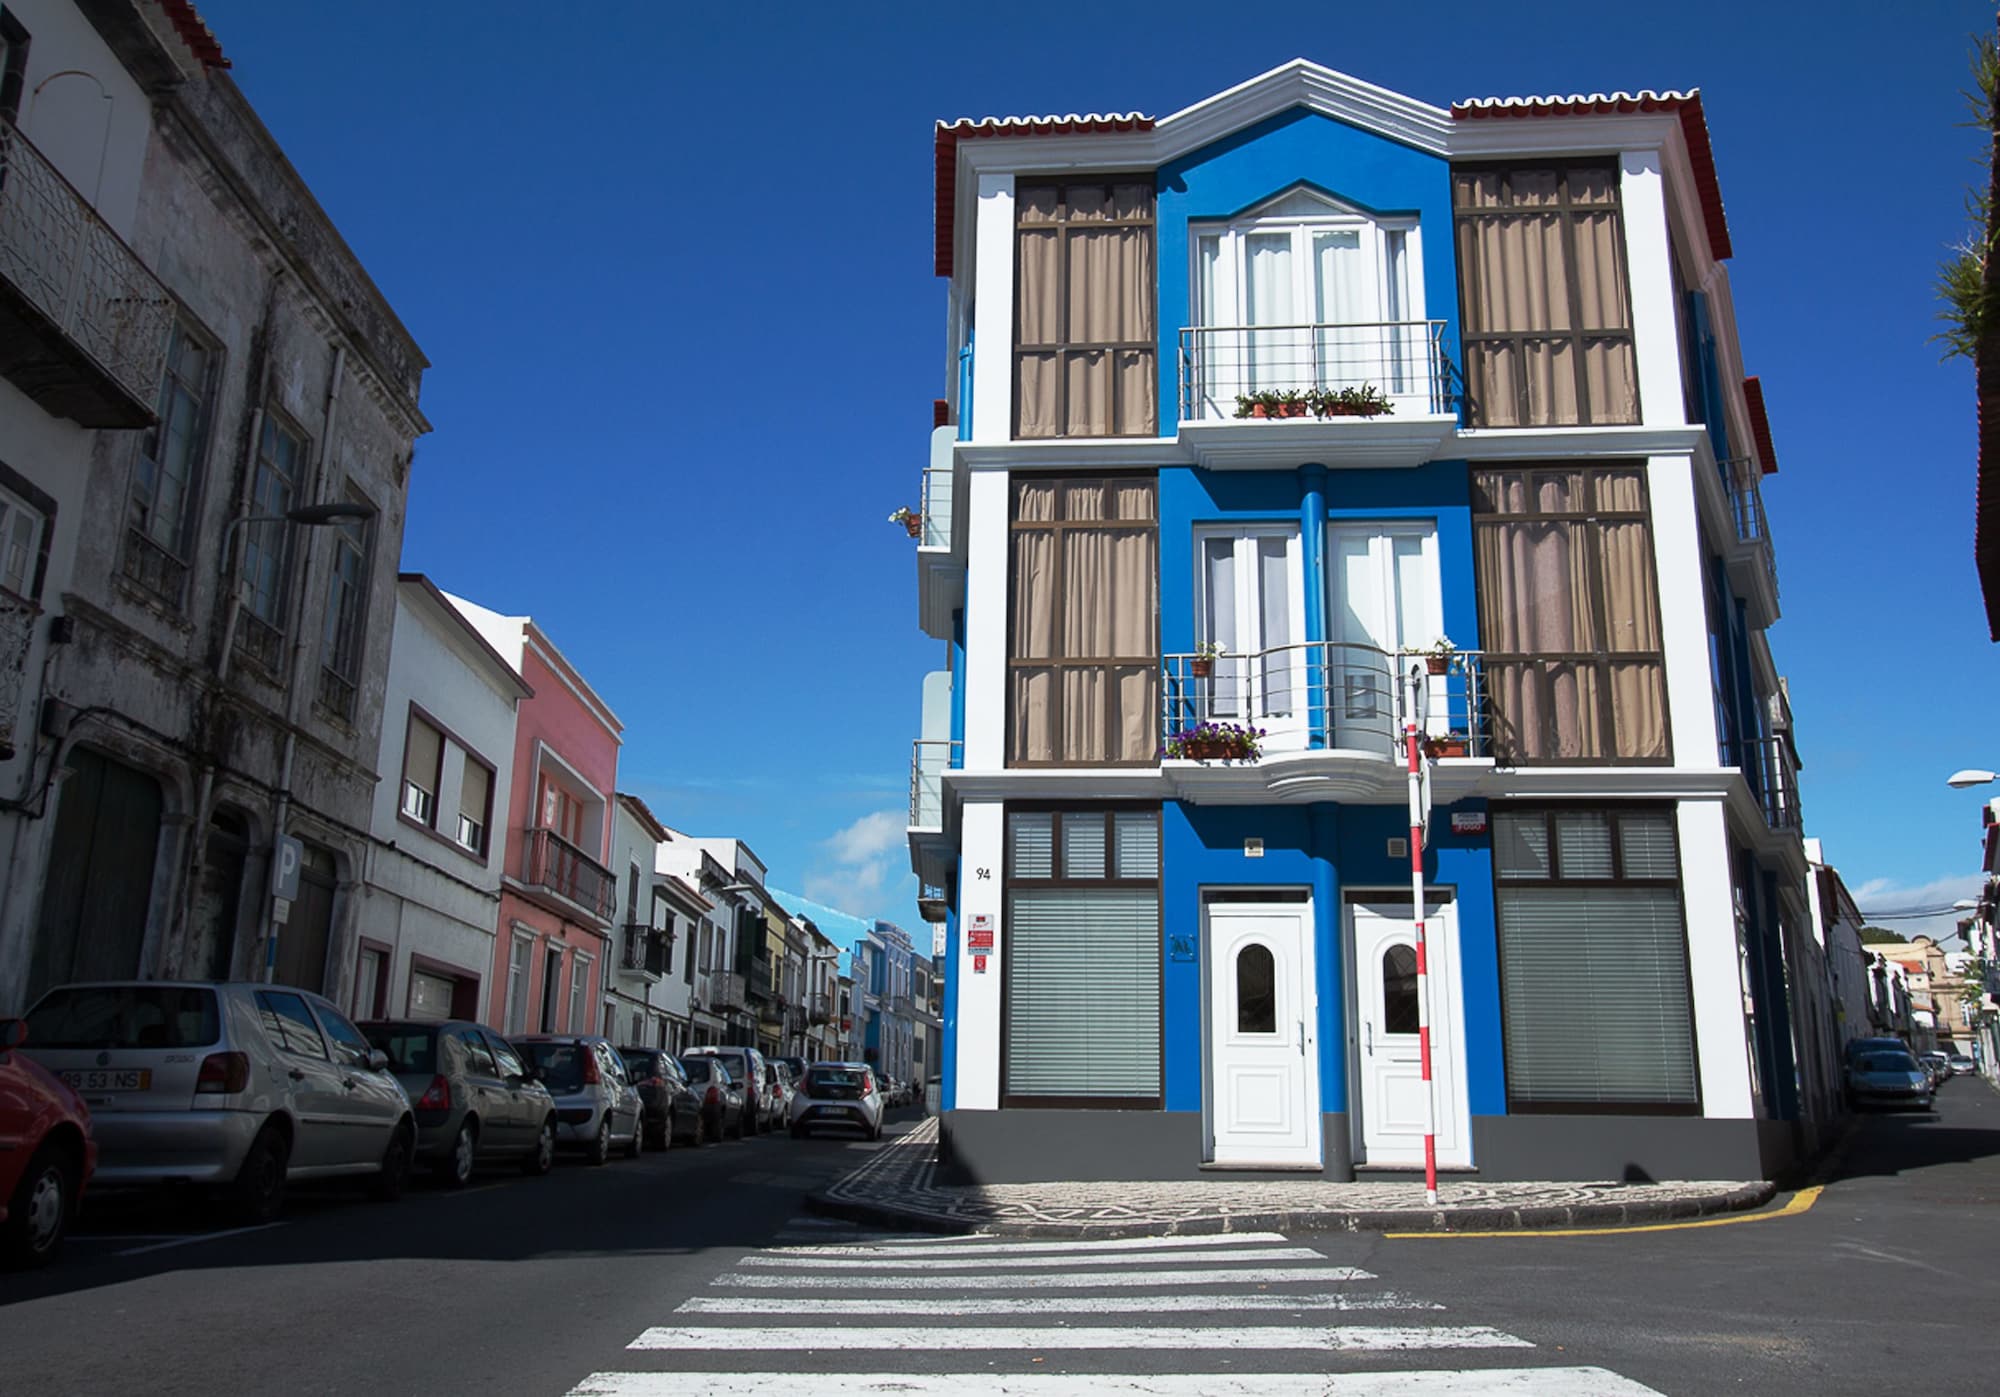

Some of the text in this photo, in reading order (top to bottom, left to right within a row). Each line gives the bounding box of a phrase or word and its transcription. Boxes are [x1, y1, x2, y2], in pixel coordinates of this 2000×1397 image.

[278, 843, 296, 888] P
[976, 867, 991, 880] 94
[88, 1072, 107, 1088] 53
[114, 1071, 138, 1087] NS
